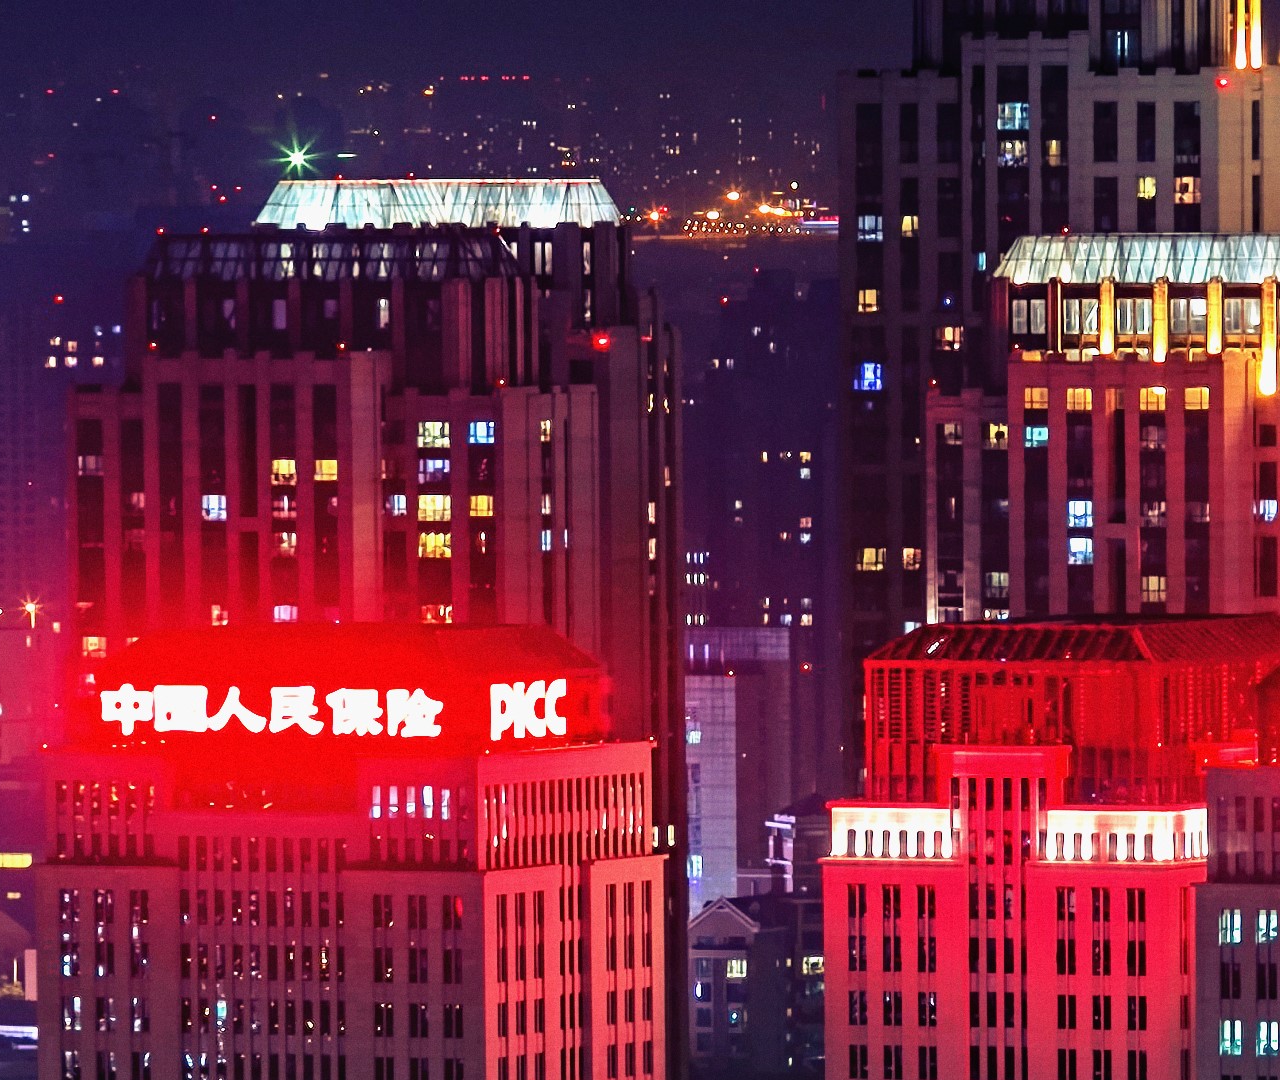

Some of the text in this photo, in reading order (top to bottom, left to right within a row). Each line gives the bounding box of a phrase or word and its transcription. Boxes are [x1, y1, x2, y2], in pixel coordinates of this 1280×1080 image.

[100, 683, 444, 738] 中国人民保险
[490, 679, 567, 741] PICC
